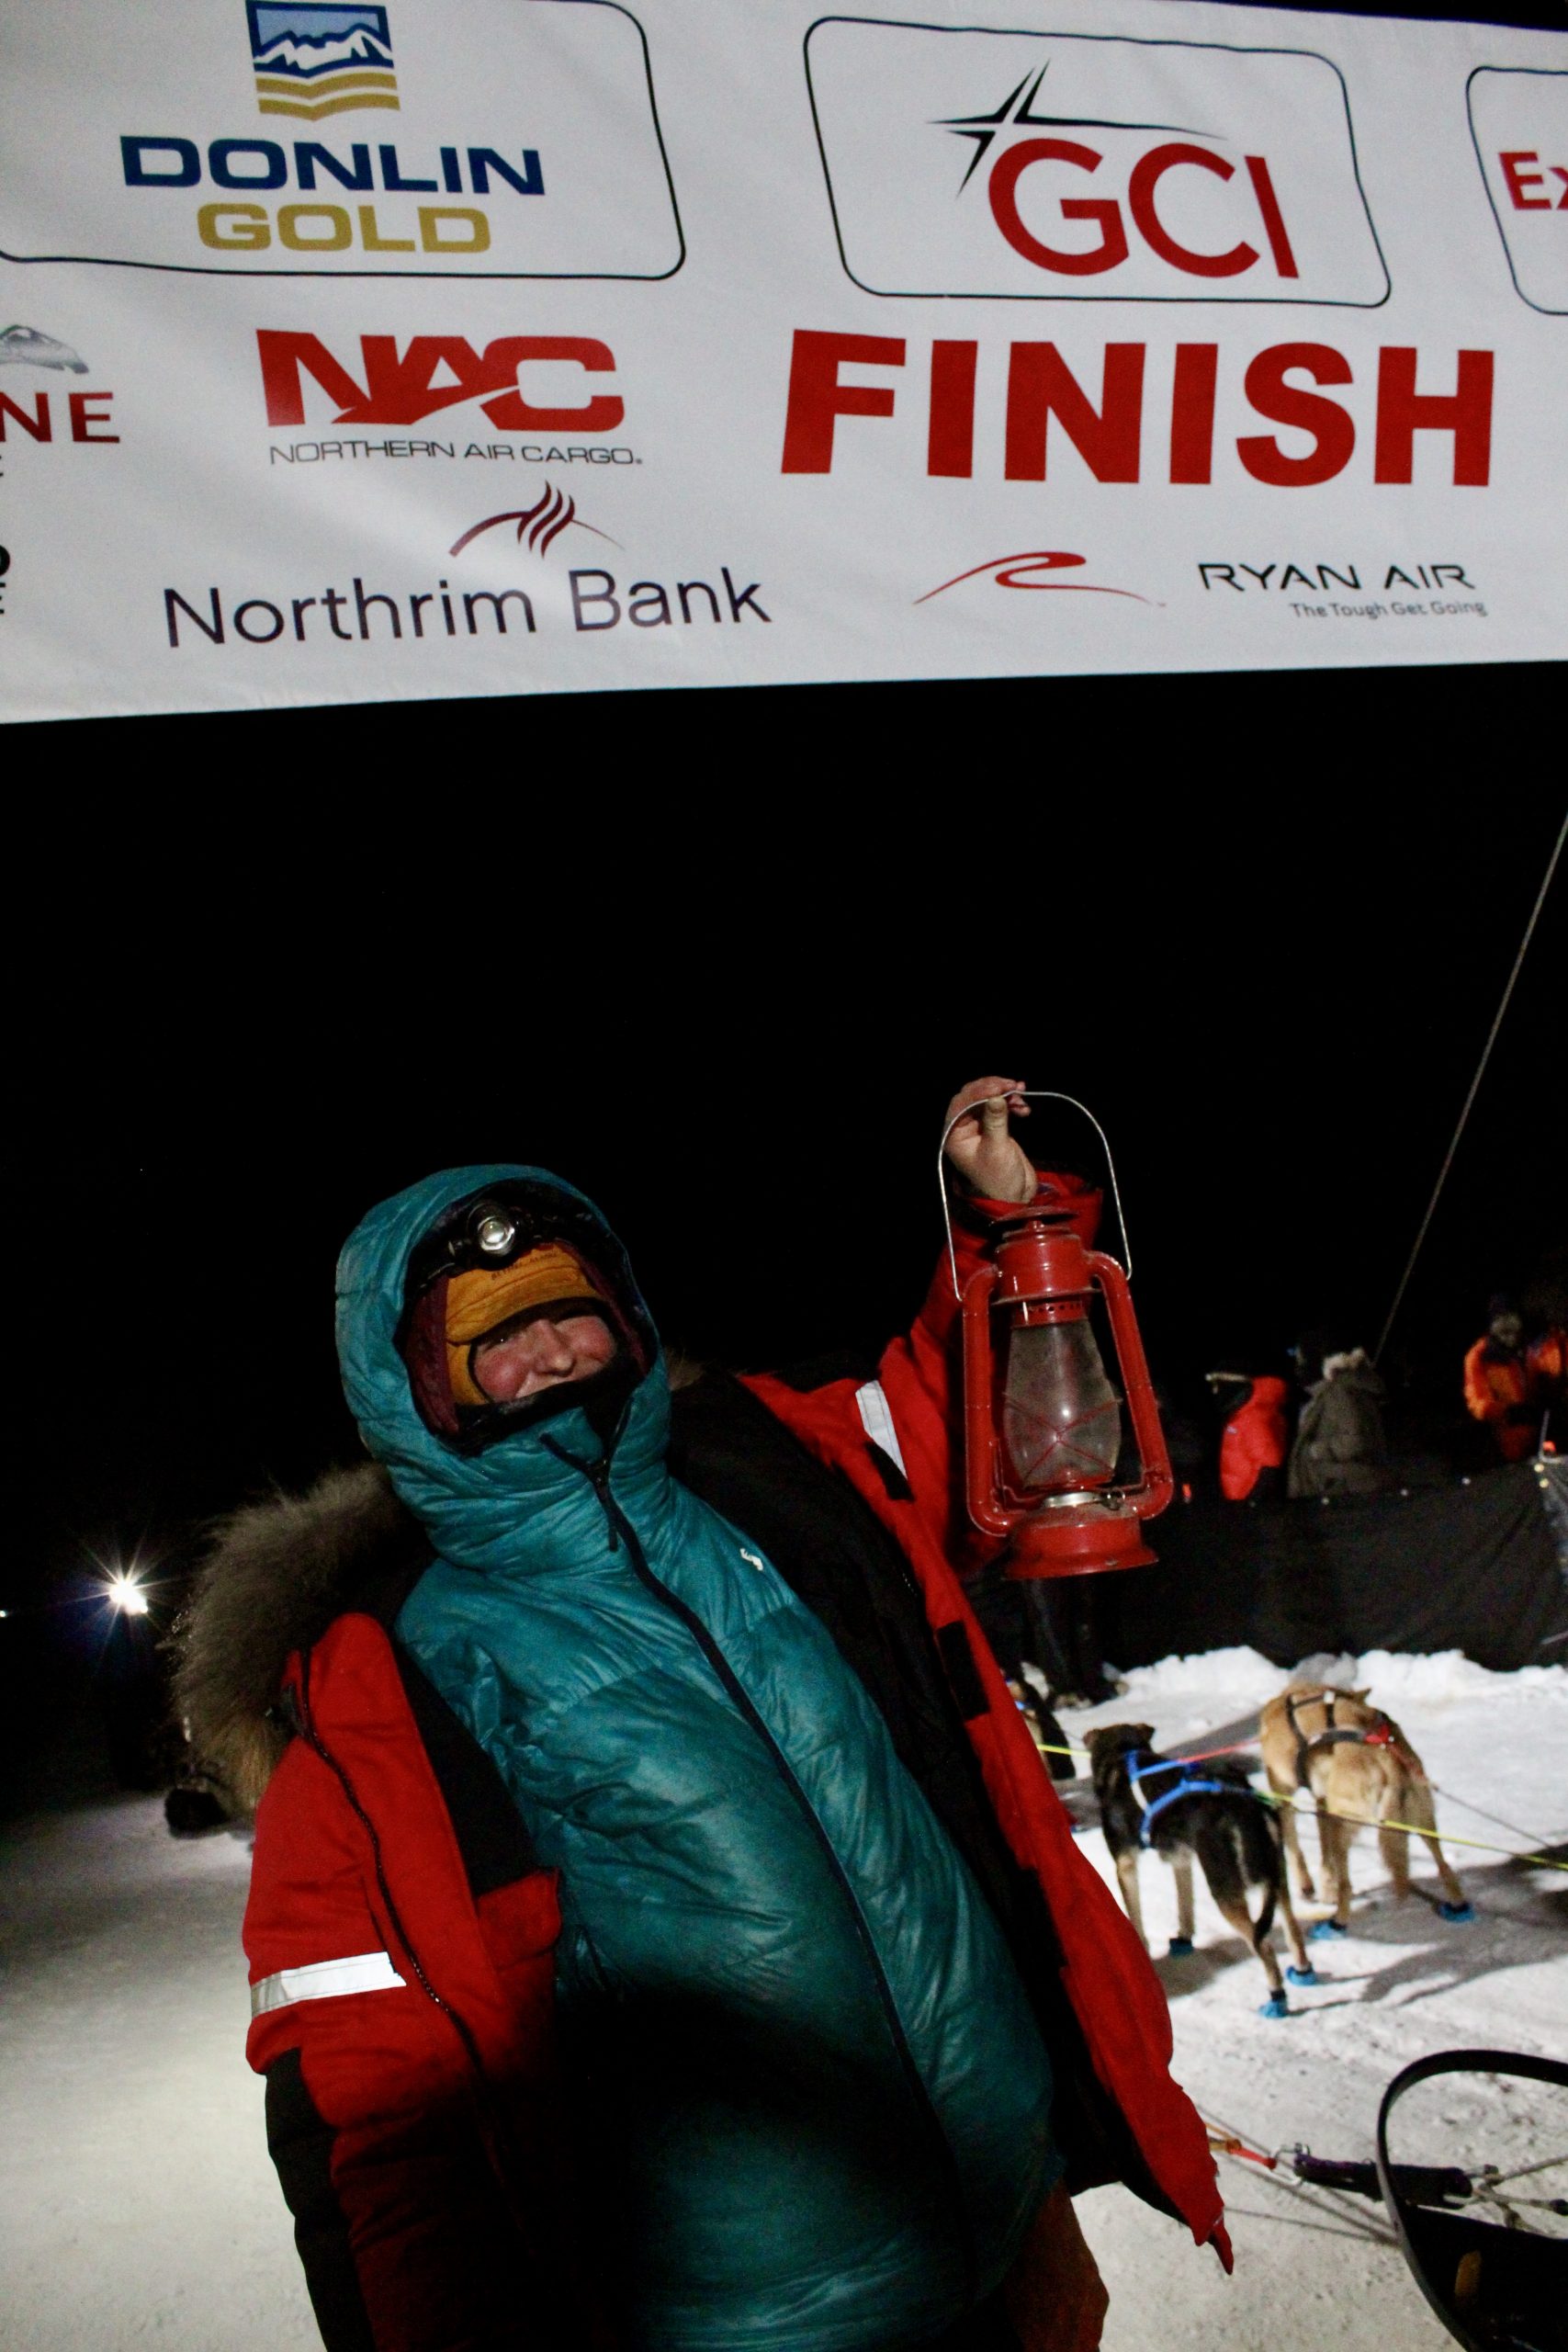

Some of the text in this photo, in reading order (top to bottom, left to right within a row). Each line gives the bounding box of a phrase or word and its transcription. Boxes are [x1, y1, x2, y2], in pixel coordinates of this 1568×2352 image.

[119, 135, 546, 196] DONLIN
[197, 203, 491, 254] GOLD
[987, 138, 1300, 279] GCI
[255, 329, 625, 432] NAC
[781, 329, 1495, 487] FINISH
[270, 440, 456, 465] NORTHERN
[463, 443, 515, 460] AIR
[164, 567, 772, 648] Northrim Bank
[1198, 562, 1475, 592] RYAN AIR
[1290, 600, 1488, 620] The Tough Get Going
